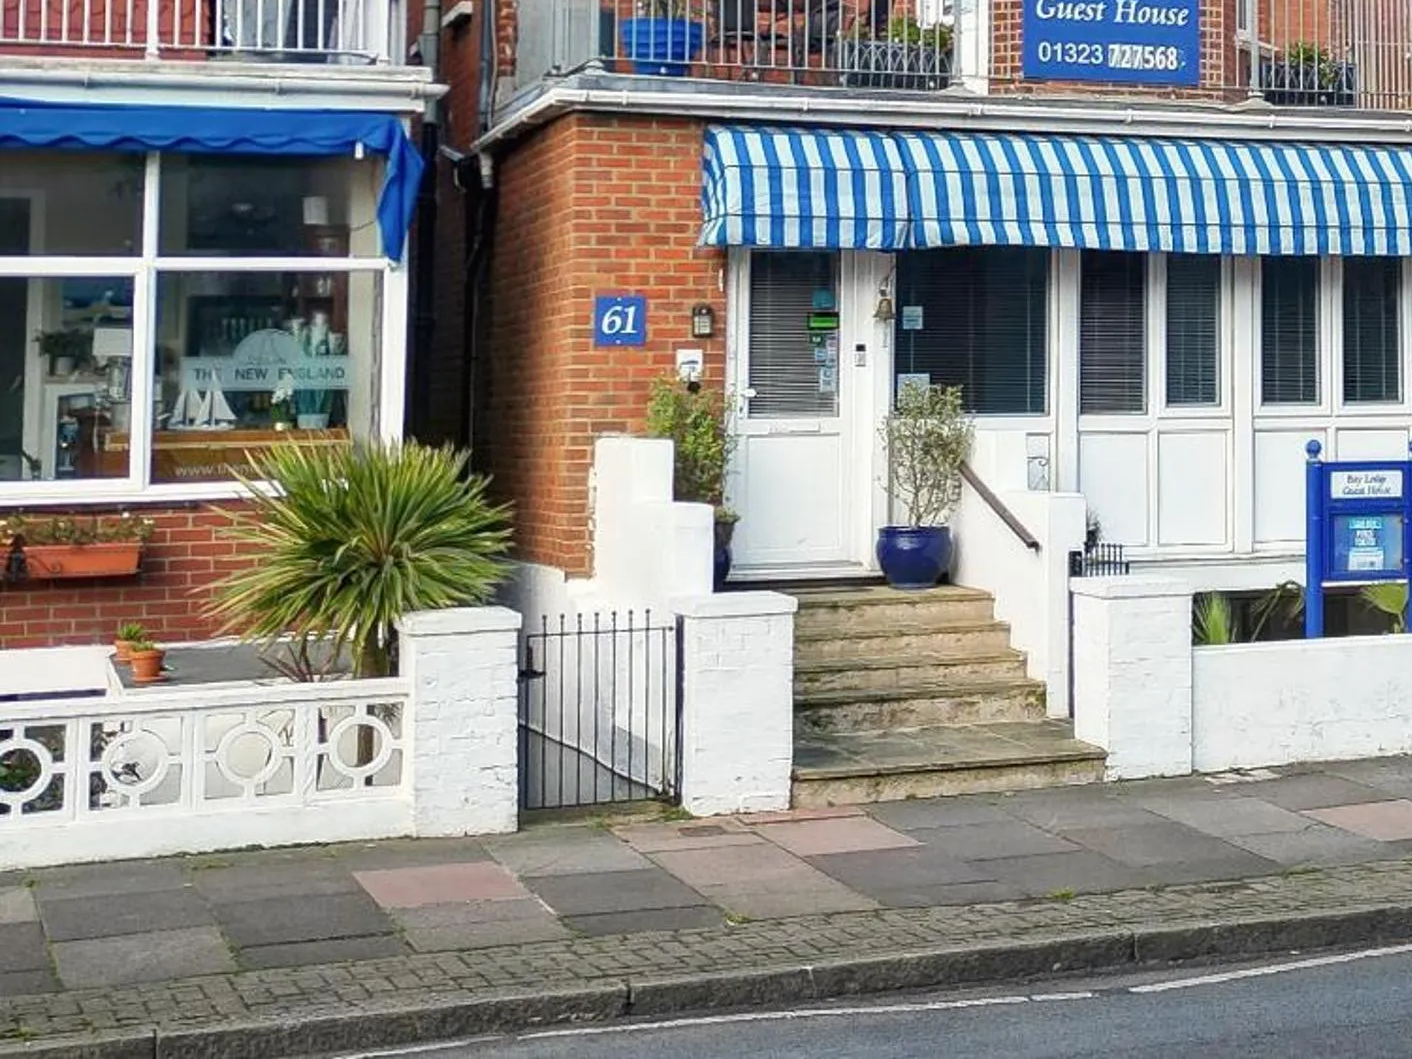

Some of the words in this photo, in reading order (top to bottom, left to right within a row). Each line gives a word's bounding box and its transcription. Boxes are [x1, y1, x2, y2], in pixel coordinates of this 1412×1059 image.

[1113, 0, 1190, 27] House
[1038, 41, 1104, 64] 01323
[601, 305, 638, 335] 61
[235, 368, 268, 380] NEW
